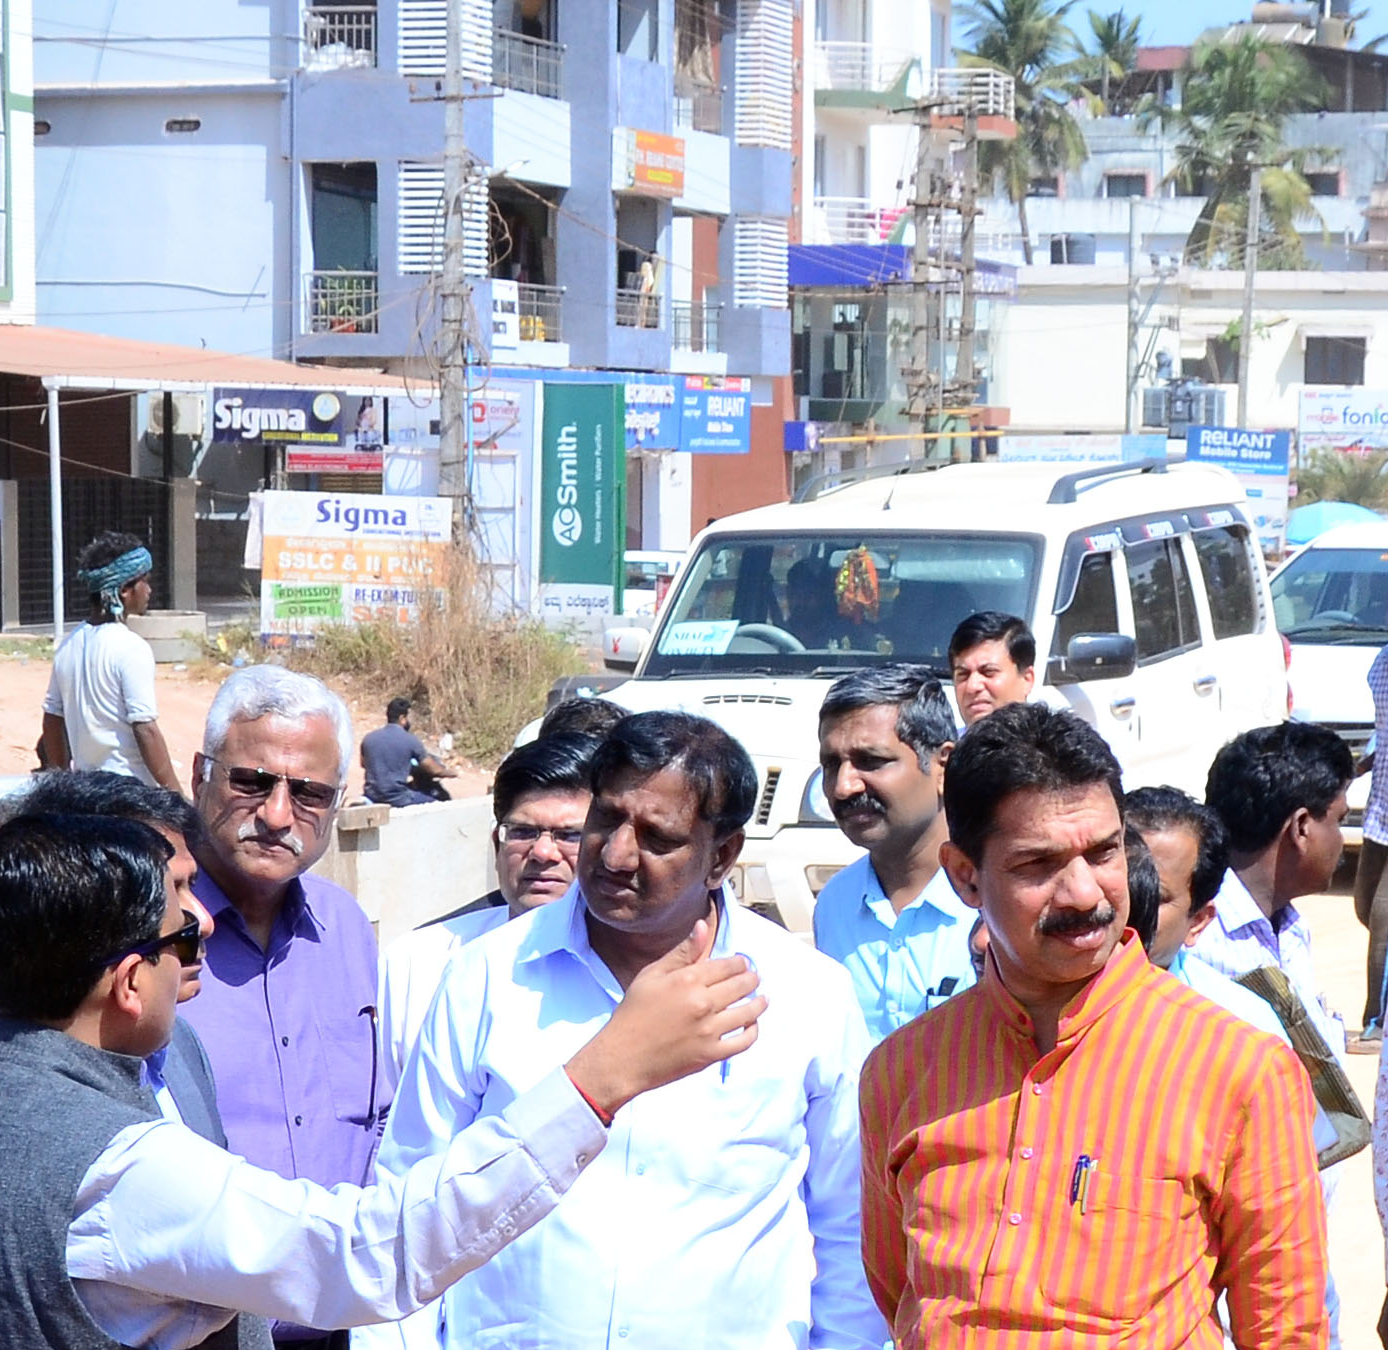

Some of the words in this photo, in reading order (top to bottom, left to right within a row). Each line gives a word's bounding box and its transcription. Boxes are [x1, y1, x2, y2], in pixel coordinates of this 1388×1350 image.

[215, 397, 306, 439] Sigma
[594, 424, 603, 457] Purifiers
[1199, 446, 1238, 458] Mobile
[1240, 448, 1272, 460] Store
[594, 457, 603, 481] Water
[316, 499, 408, 533] Sigma
[594, 521, 603, 544] Water
[279, 551, 335, 570] SSLC
[341, 553, 358, 572] &
[278, 585, 340, 600] ADMISSION
[288, 604, 327, 616] OPEN
